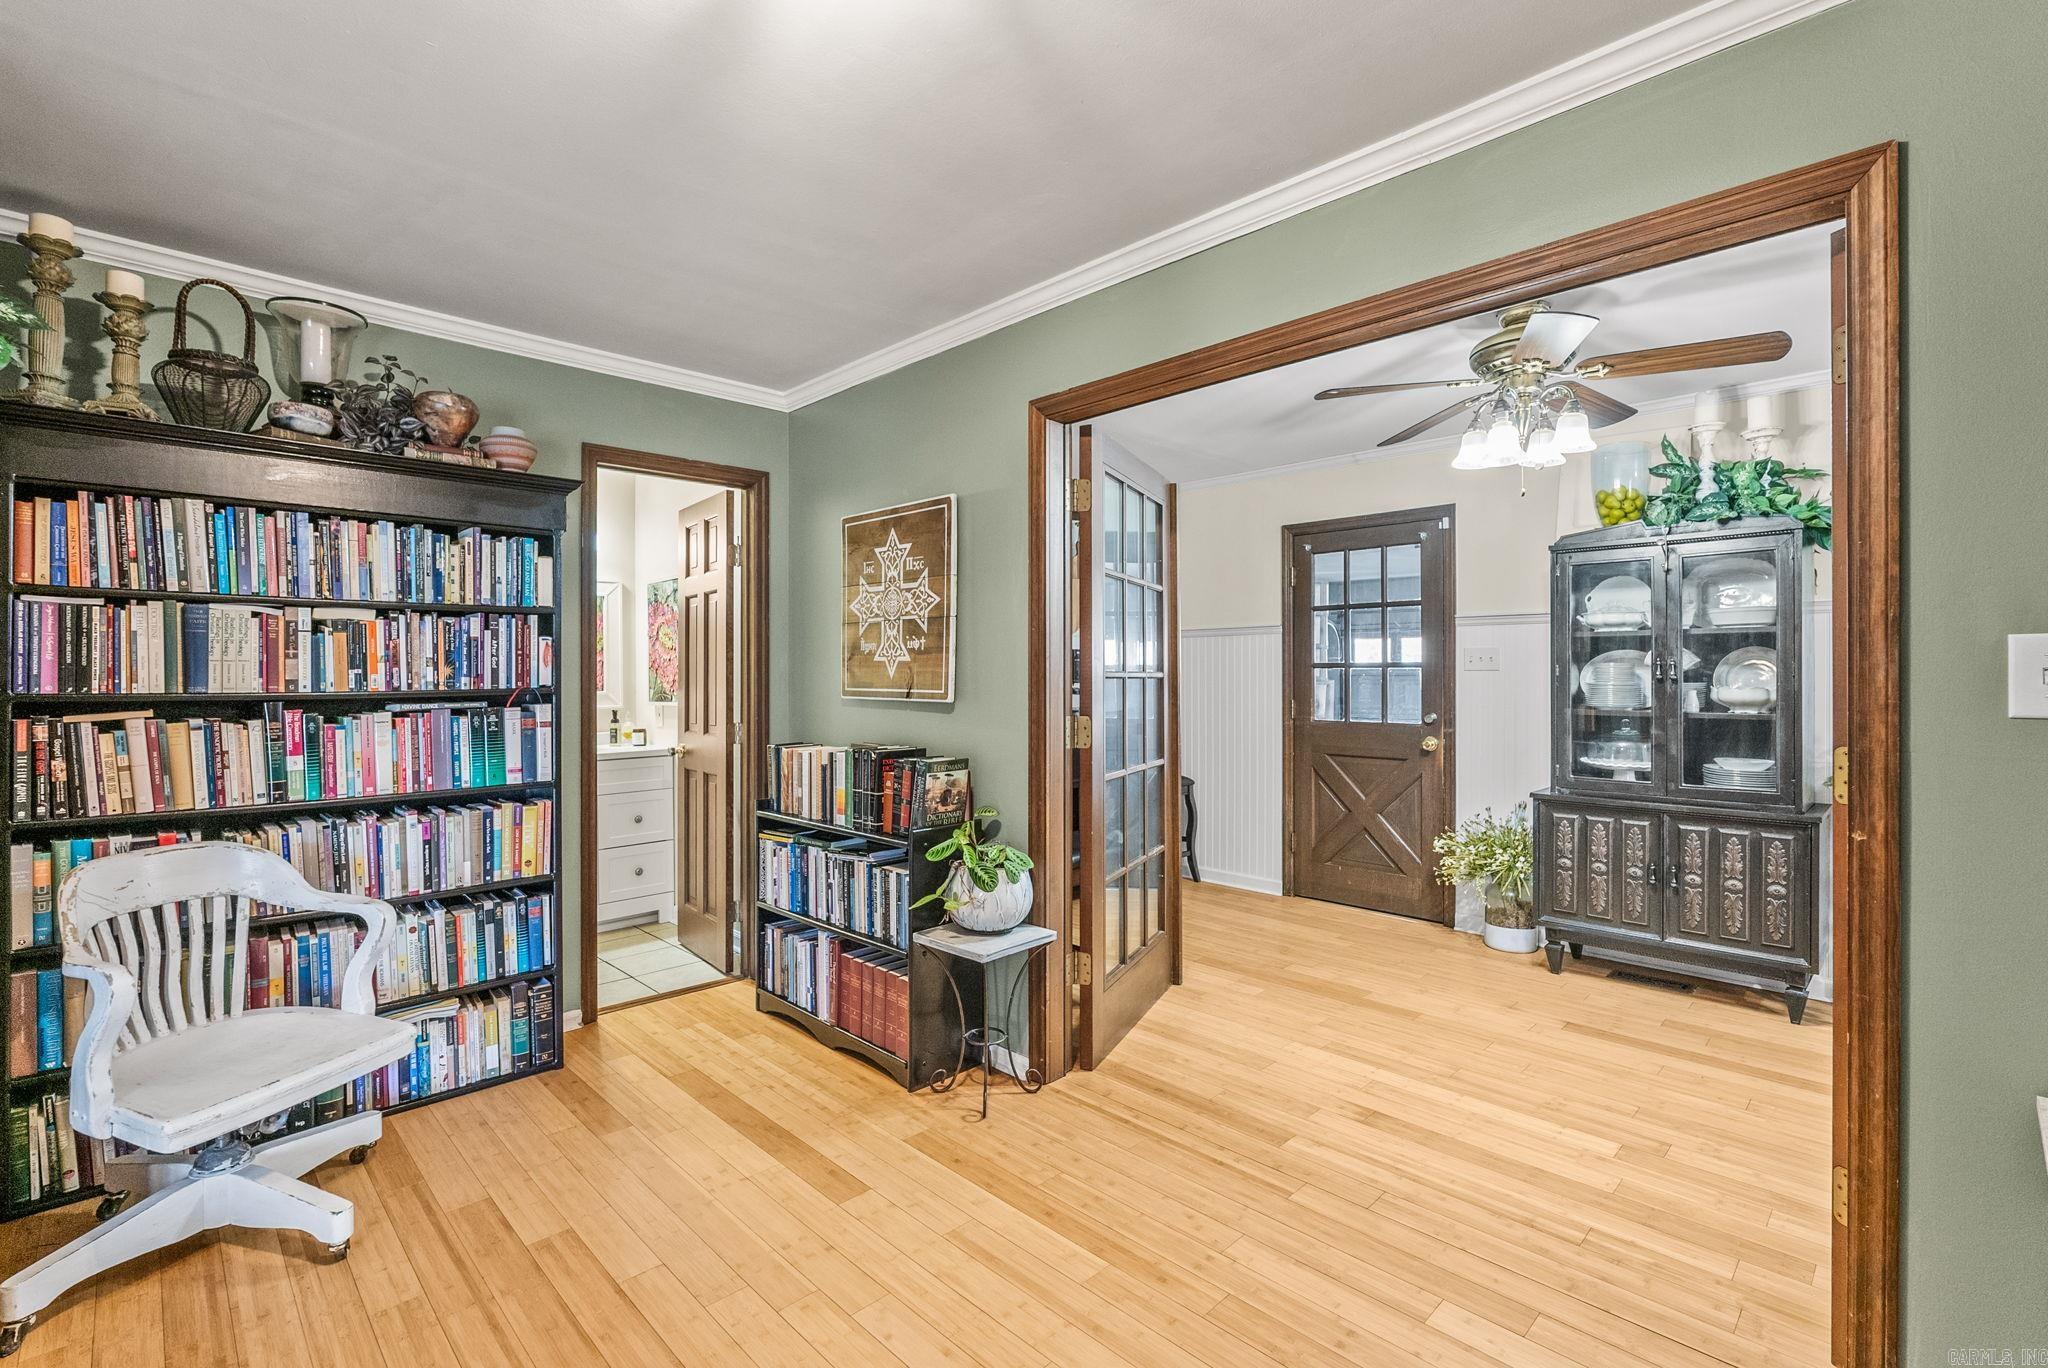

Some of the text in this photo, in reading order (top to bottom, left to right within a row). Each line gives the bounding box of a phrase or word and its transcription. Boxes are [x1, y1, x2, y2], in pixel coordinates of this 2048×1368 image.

[54, 738, 62, 756] Gospel
[104, 760, 114, 774] GOSPELS
[934, 764, 965, 772] EERDMANS
[14, 756, 27, 803] THE FIVE GOSPELS
[108, 784, 116, 794] JESUS
[926, 810, 962, 822] DICTIONARY
[115, 846, 128, 854] NIV
[46, 1038, 61, 1063] John
